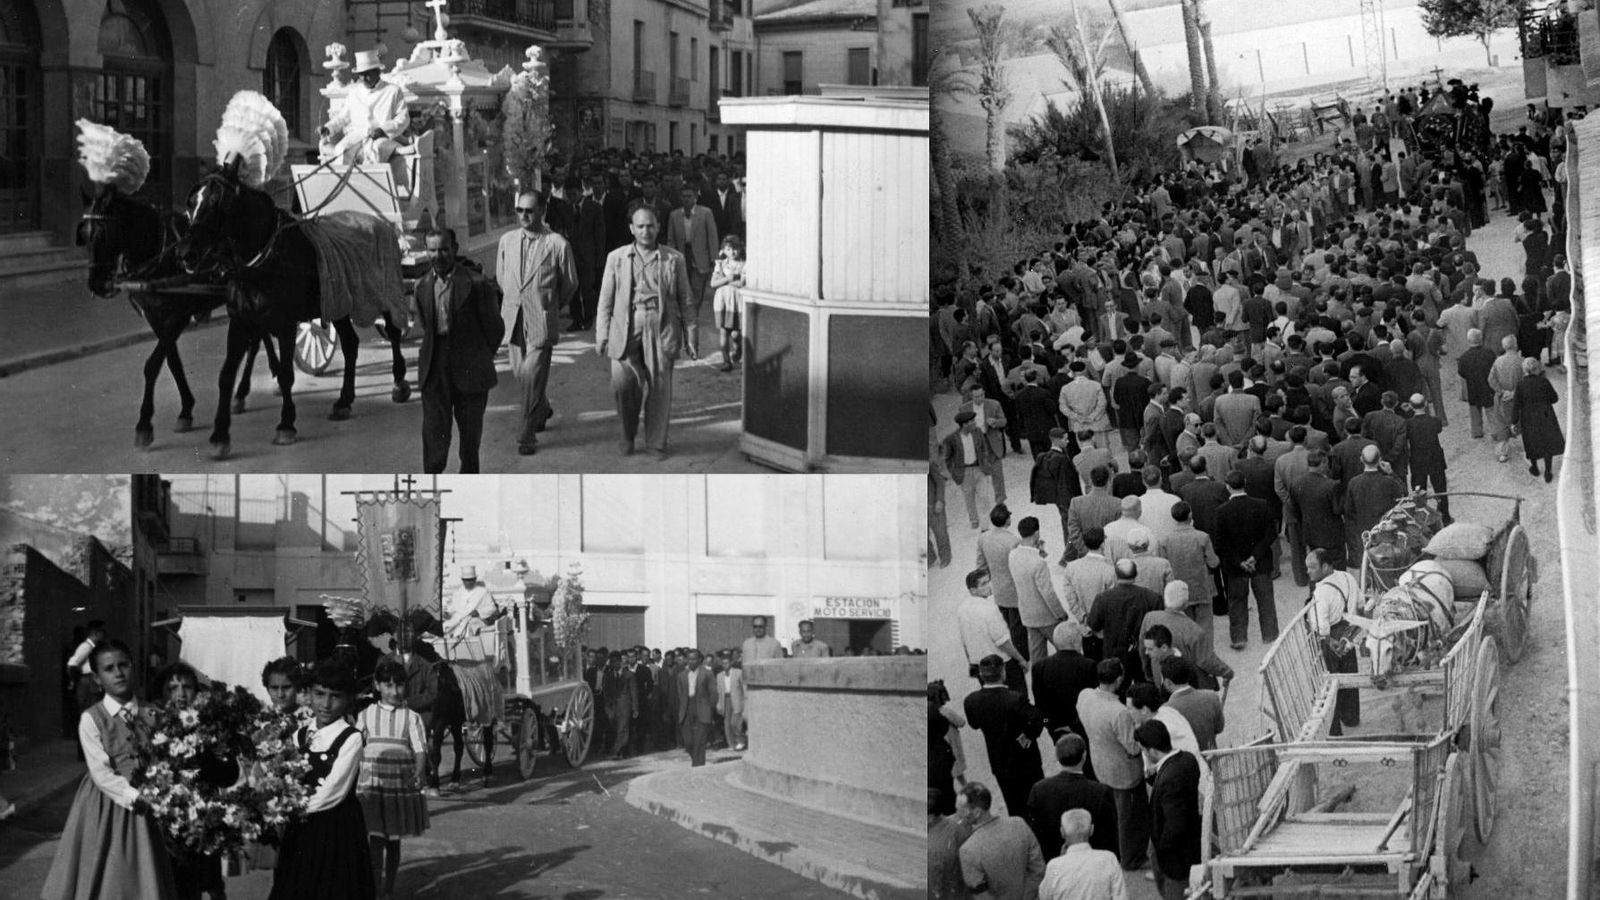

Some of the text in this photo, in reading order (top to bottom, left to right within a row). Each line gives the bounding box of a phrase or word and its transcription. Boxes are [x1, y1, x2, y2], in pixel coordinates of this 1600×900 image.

[826, 597, 880, 607] ESTACION
[814, 608, 891, 617] MOTO SERVICIO
